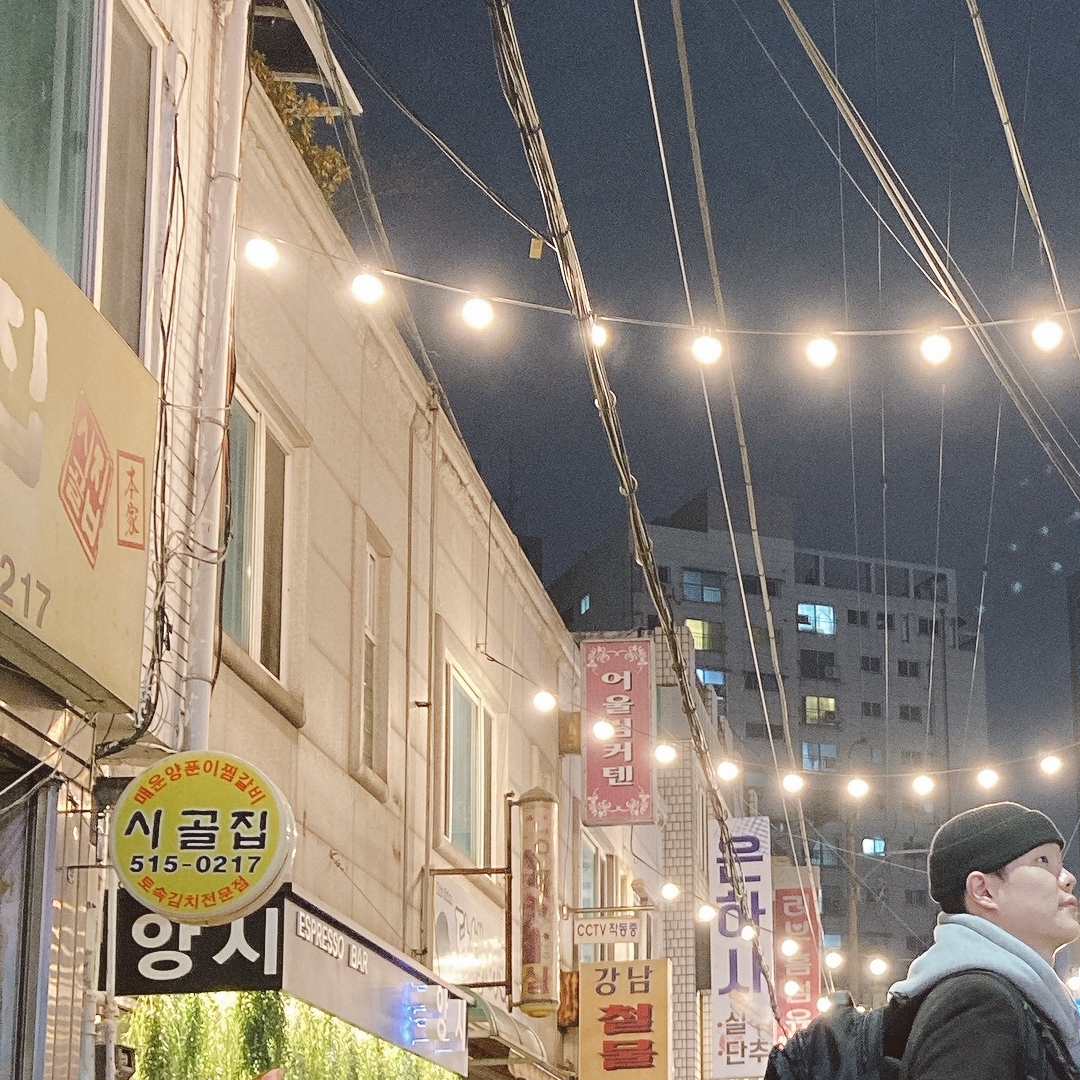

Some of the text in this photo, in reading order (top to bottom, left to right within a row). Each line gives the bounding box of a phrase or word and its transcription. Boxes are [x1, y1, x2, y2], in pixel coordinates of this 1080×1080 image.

[125, 810, 267, 850] 시골집
[130, 856, 261, 873] 515-0217
[138, 876, 249, 909] 토속김치전문점
[296, 910, 368, 974] ESPRESSO BAR
[577, 922, 637, 937] CCTV 작동중
[595, 965, 654, 997] 강남
[726, 1012, 745, 1035] 실
[726, 1039, 769, 1065] 단추
